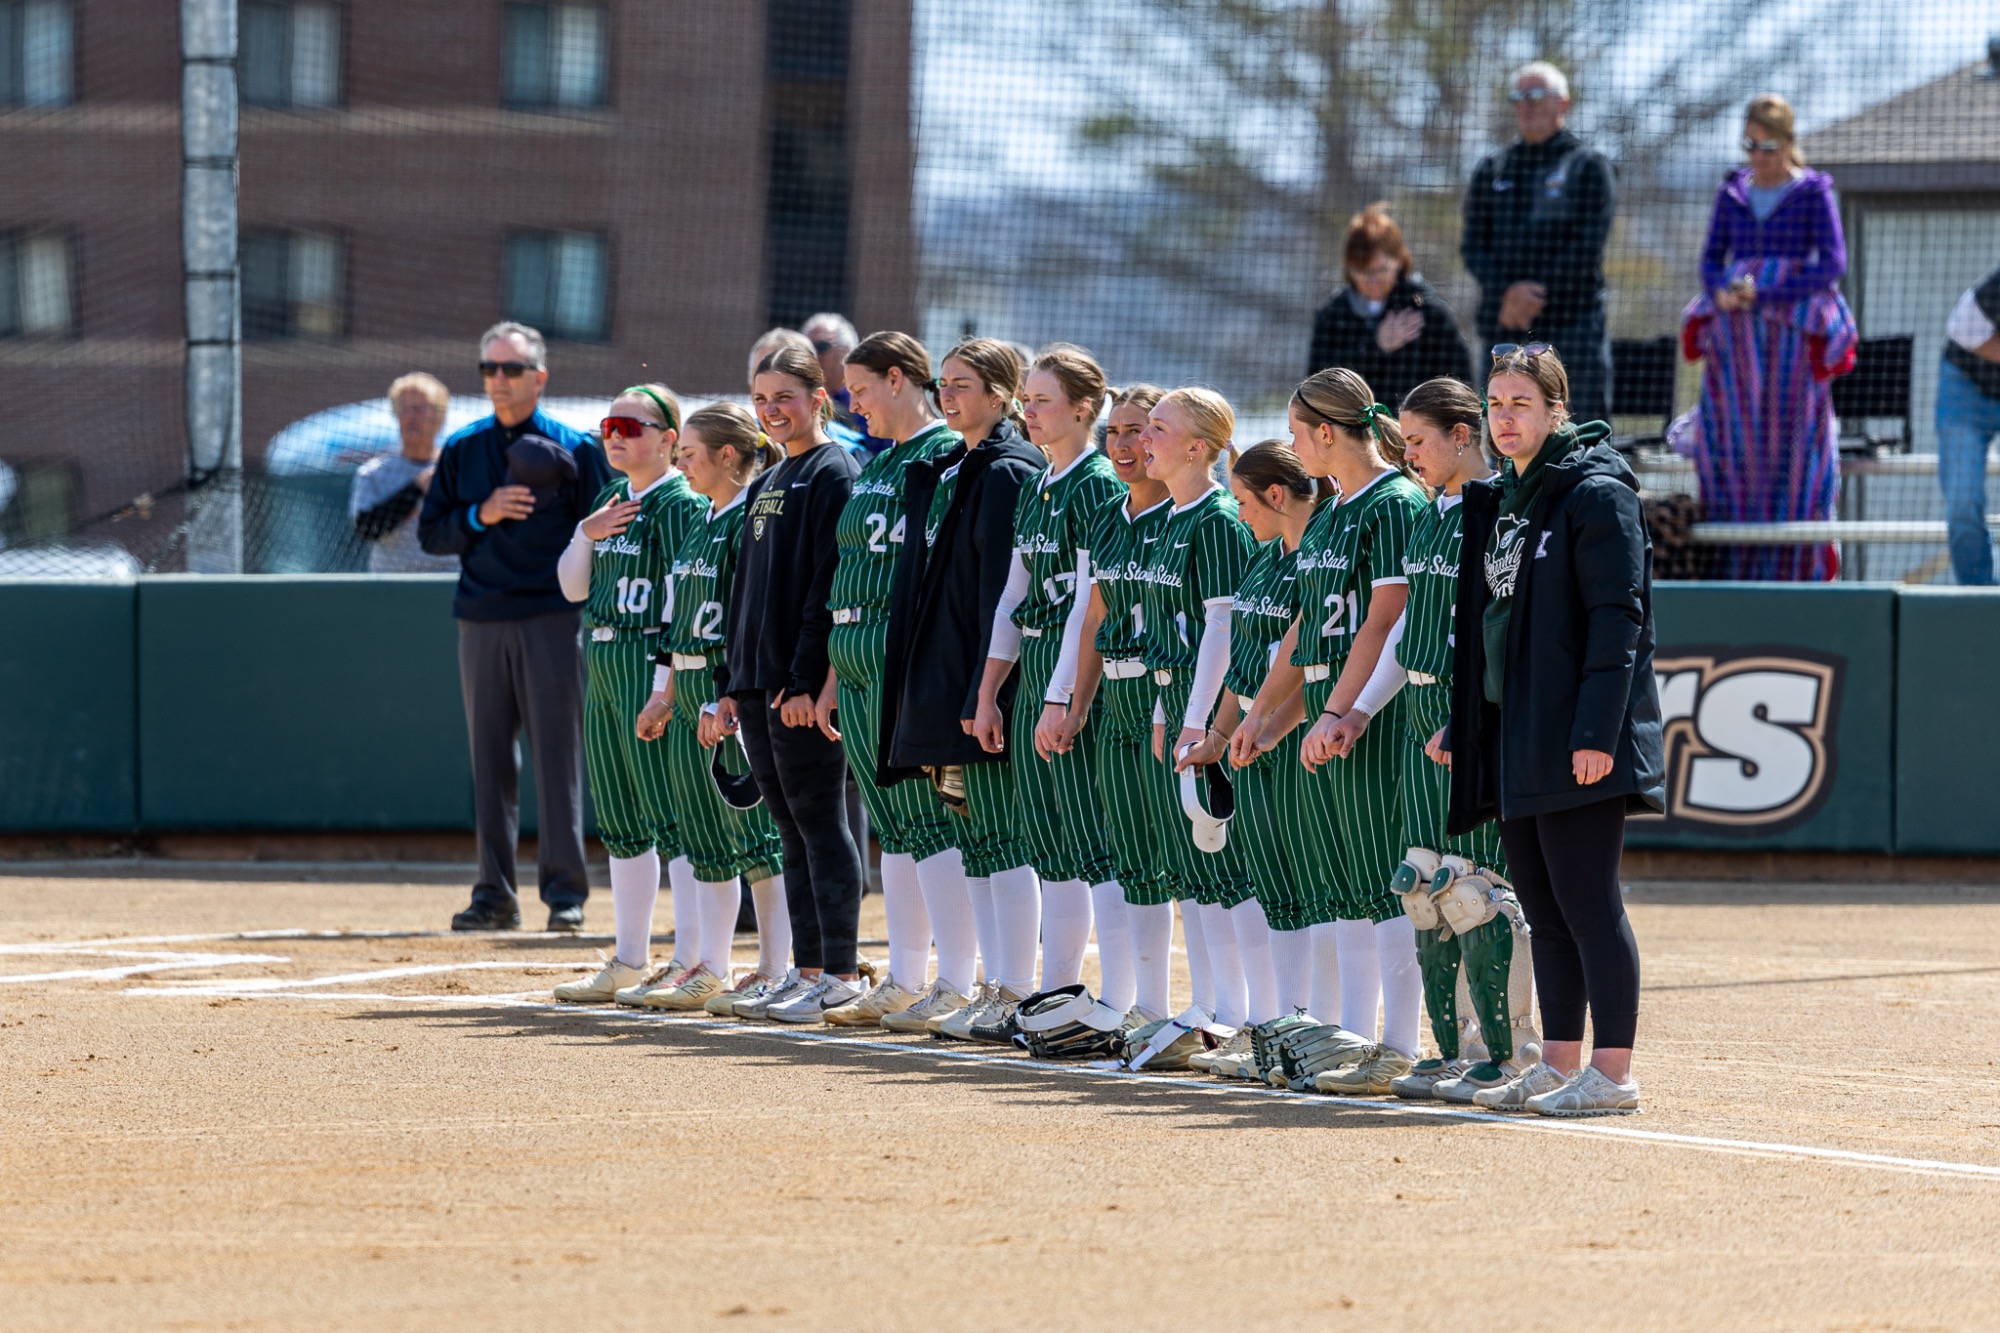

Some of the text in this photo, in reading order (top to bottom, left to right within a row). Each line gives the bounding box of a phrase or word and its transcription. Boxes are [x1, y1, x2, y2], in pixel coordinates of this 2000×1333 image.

[749, 499, 784, 515] OFTBALL
[866, 513, 906, 552] 24
[1035, 533, 1060, 553] State
[612, 535, 641, 556] State
[1123, 561, 1147, 581] Sta
[1318, 549, 1349, 570] State
[1154, 564, 1183, 587] State
[616, 576, 652, 614] 10
[1043, 571, 1076, 606] 17
[1256, 596, 1292, 619] State
[1322, 589, 1358, 638] 21
[693, 600, 723, 640] 12
